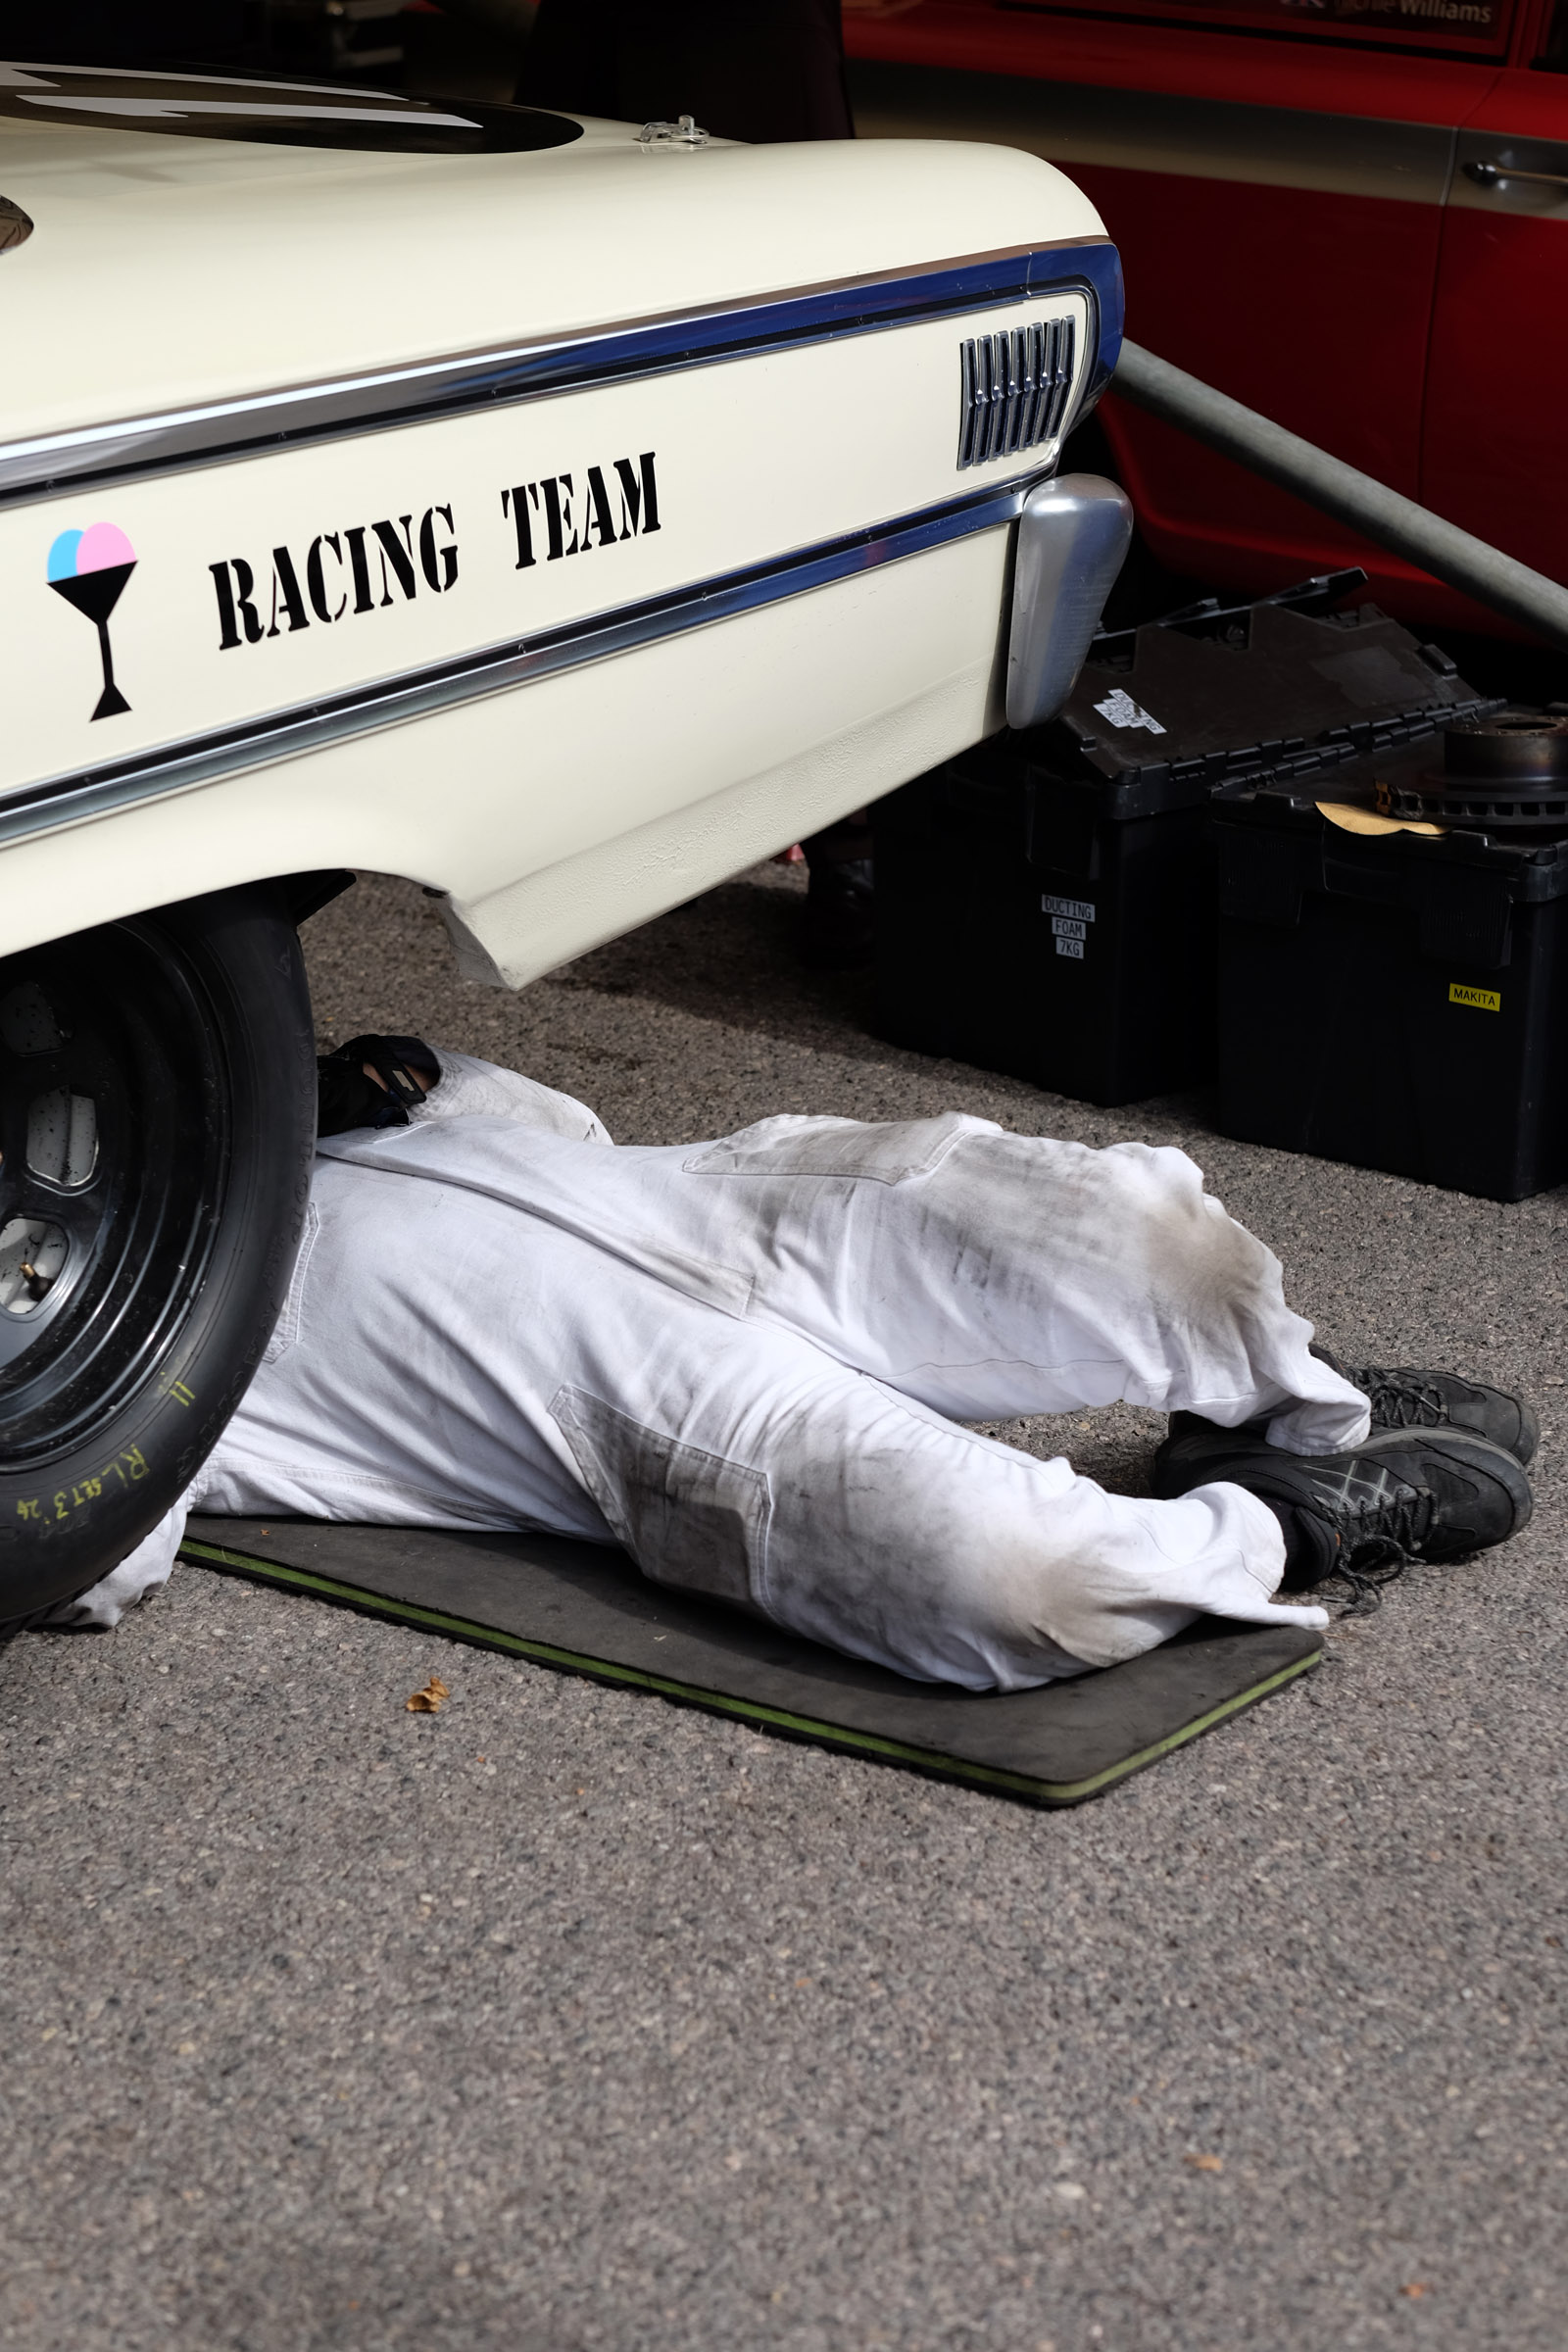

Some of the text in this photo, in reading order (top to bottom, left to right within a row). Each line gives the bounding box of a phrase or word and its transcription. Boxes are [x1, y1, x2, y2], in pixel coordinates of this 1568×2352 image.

[1400, 0, 1493, 24] Williams
[208, 451, 662, 651] RACING TEAM
[1100, 707, 1123, 725] 7KG
[1109, 701, 1139, 725] FOAM
[1114, 692, 1161, 731] DUCING
[1044, 896, 1093, 920] DUCTING
[1054, 918, 1084, 938] FOAM
[1058, 939, 1081, 956] 7KG
[1453, 987, 1496, 1006] MAKITA
[101, 1443, 150, 1489] RL
